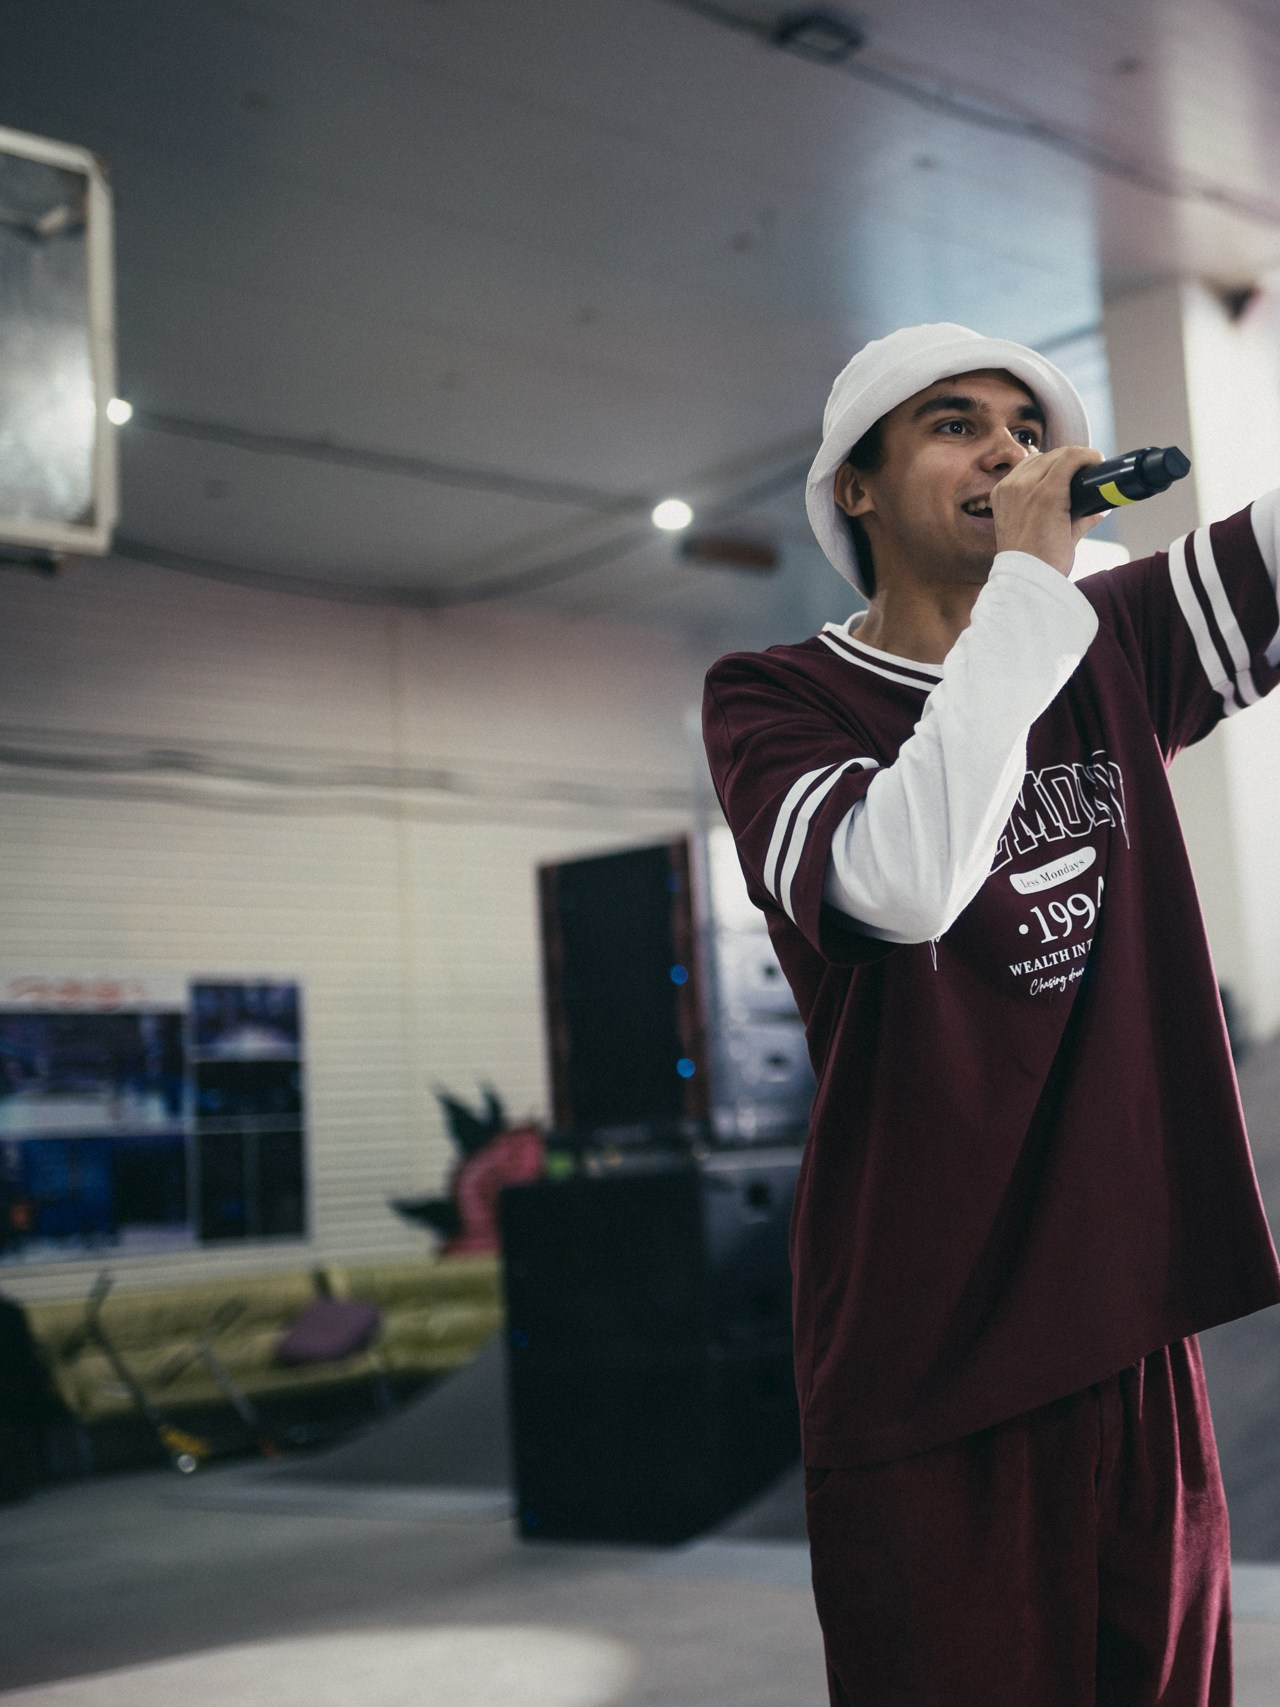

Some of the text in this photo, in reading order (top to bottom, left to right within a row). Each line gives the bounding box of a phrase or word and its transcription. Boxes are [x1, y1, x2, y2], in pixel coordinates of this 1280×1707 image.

[1040, 858, 1086, 884] Mondays
[1008, 948, 1071, 976] WEALTH
[1029, 975, 1068, 996] Chasing
